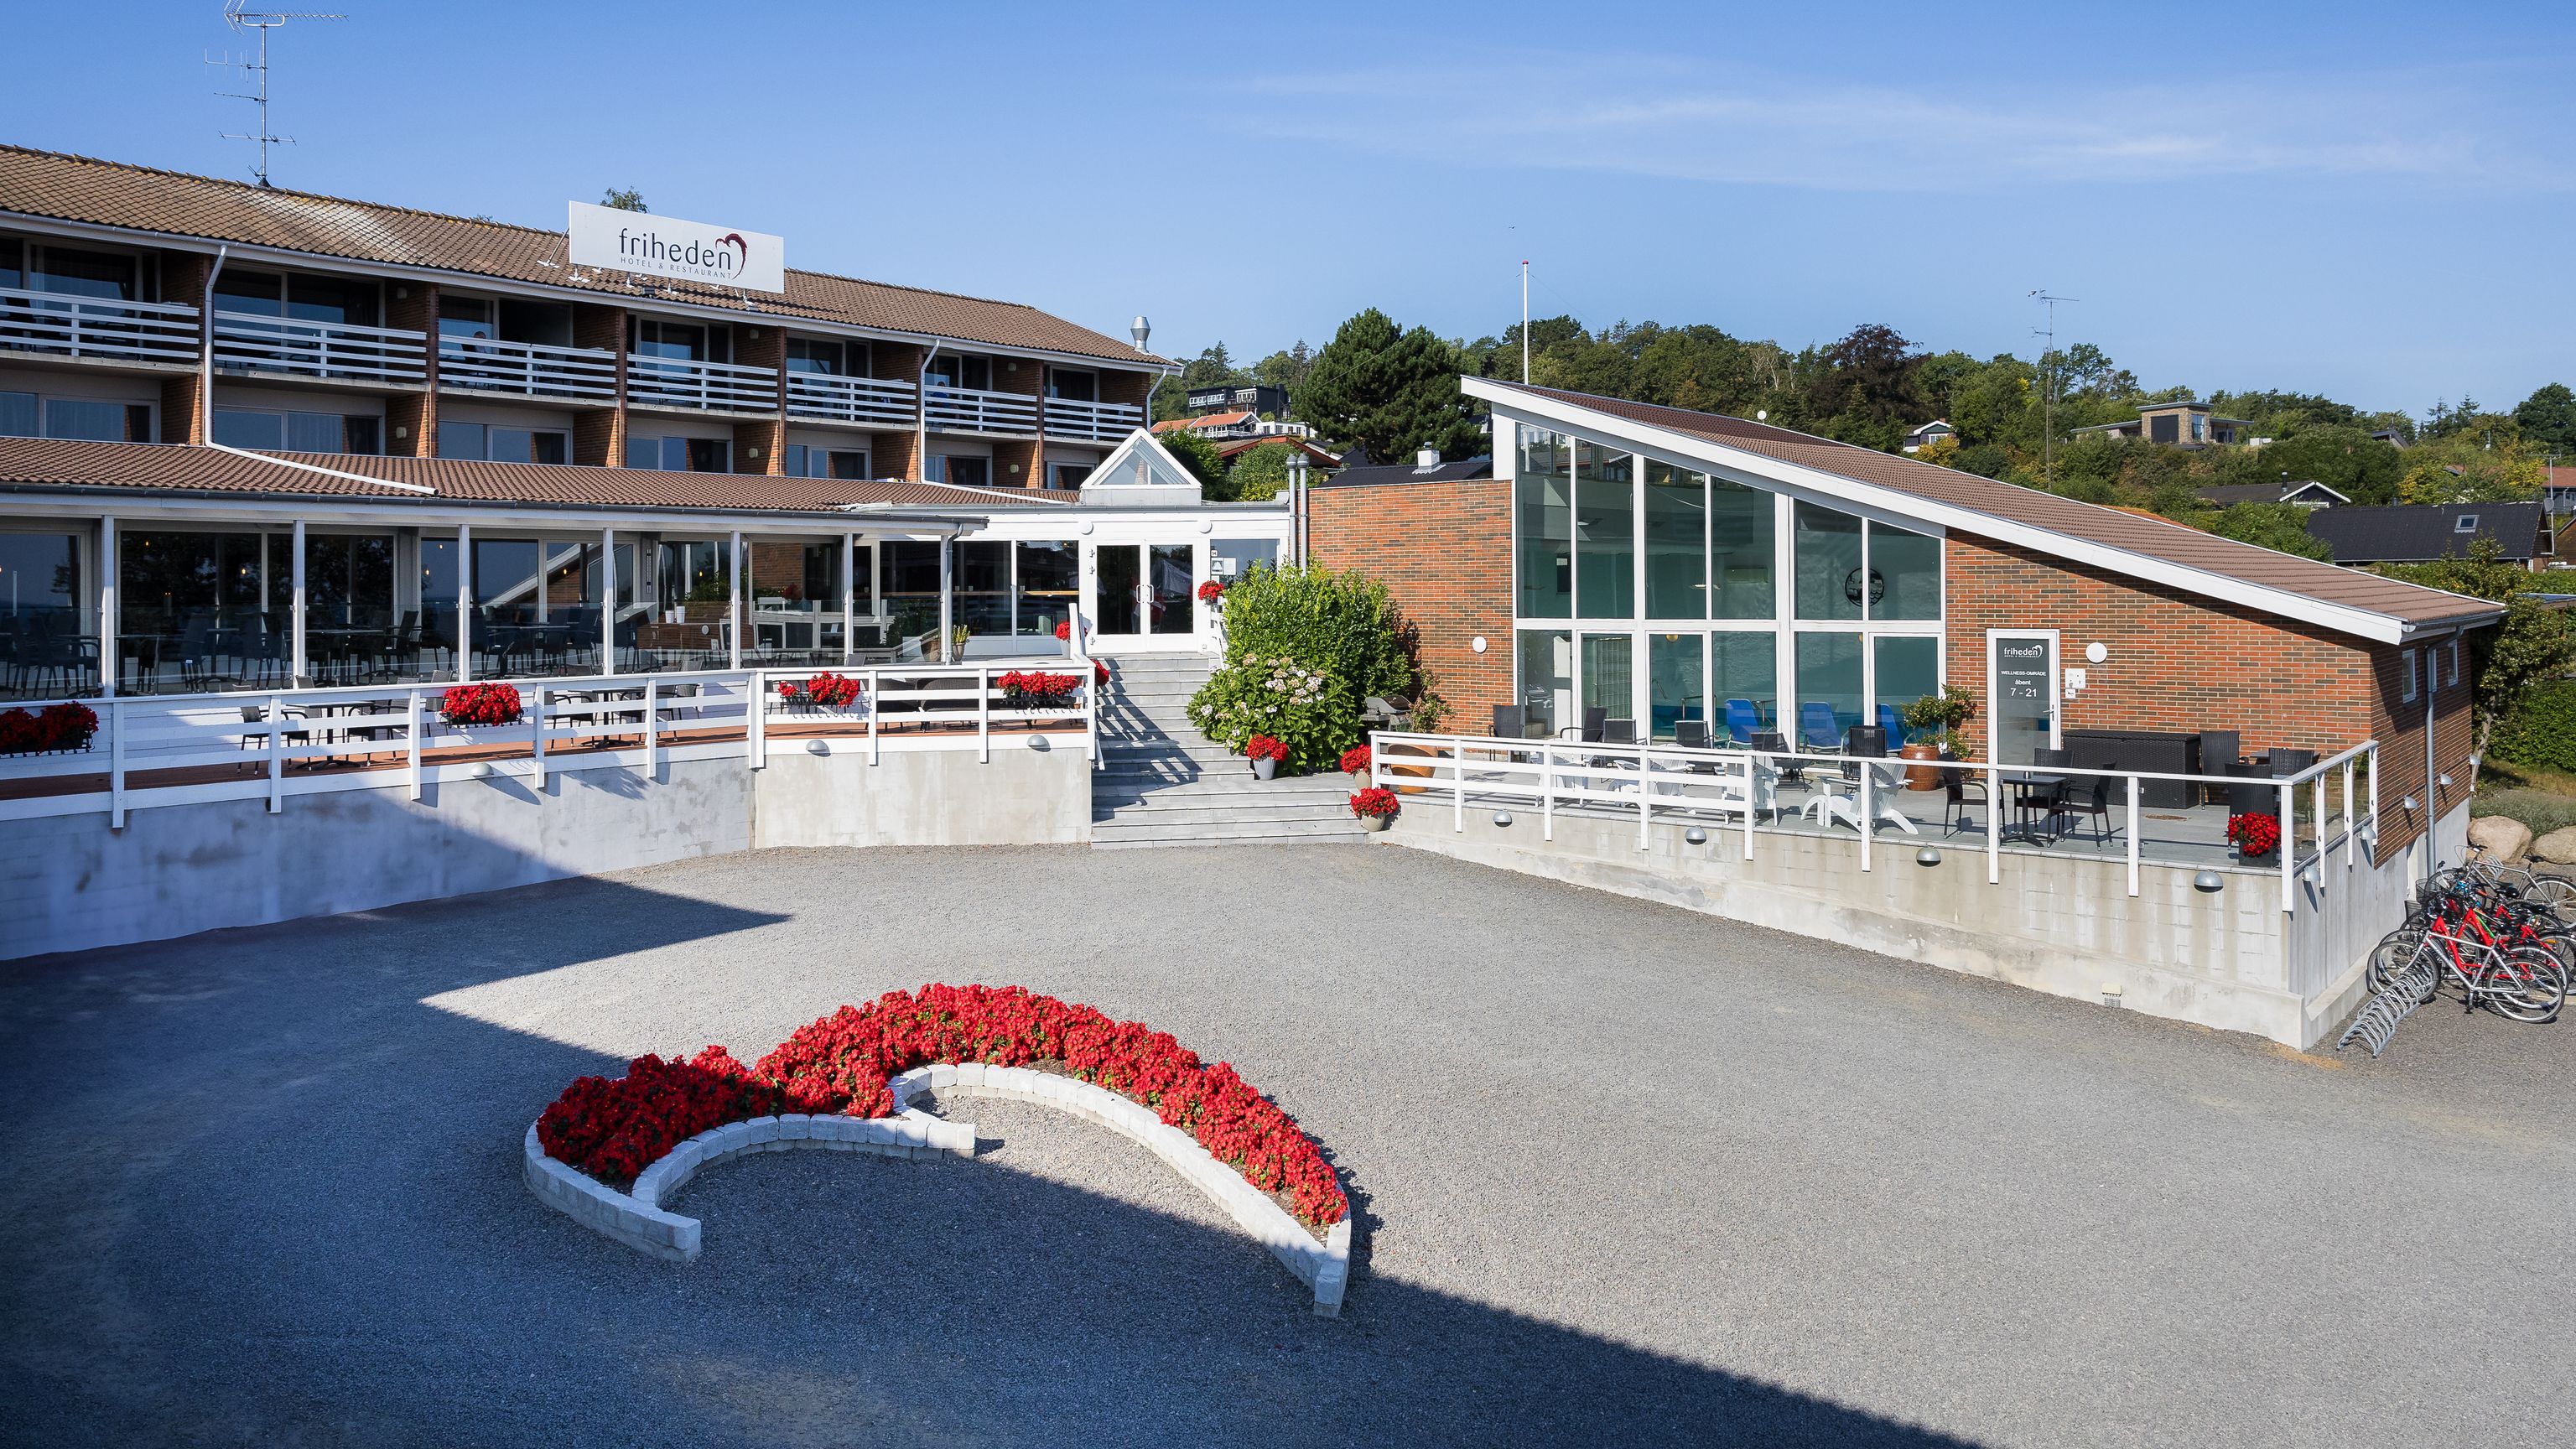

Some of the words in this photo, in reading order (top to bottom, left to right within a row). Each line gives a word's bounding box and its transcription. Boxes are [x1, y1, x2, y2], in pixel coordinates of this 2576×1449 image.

[619, 227, 731, 270] friheden
[621, 257, 652, 267] HOTEL
[670, 264, 732, 278] RESTAURANT
[2010, 688, 2017, 696] 7
[2025, 688, 2037, 697] 21
